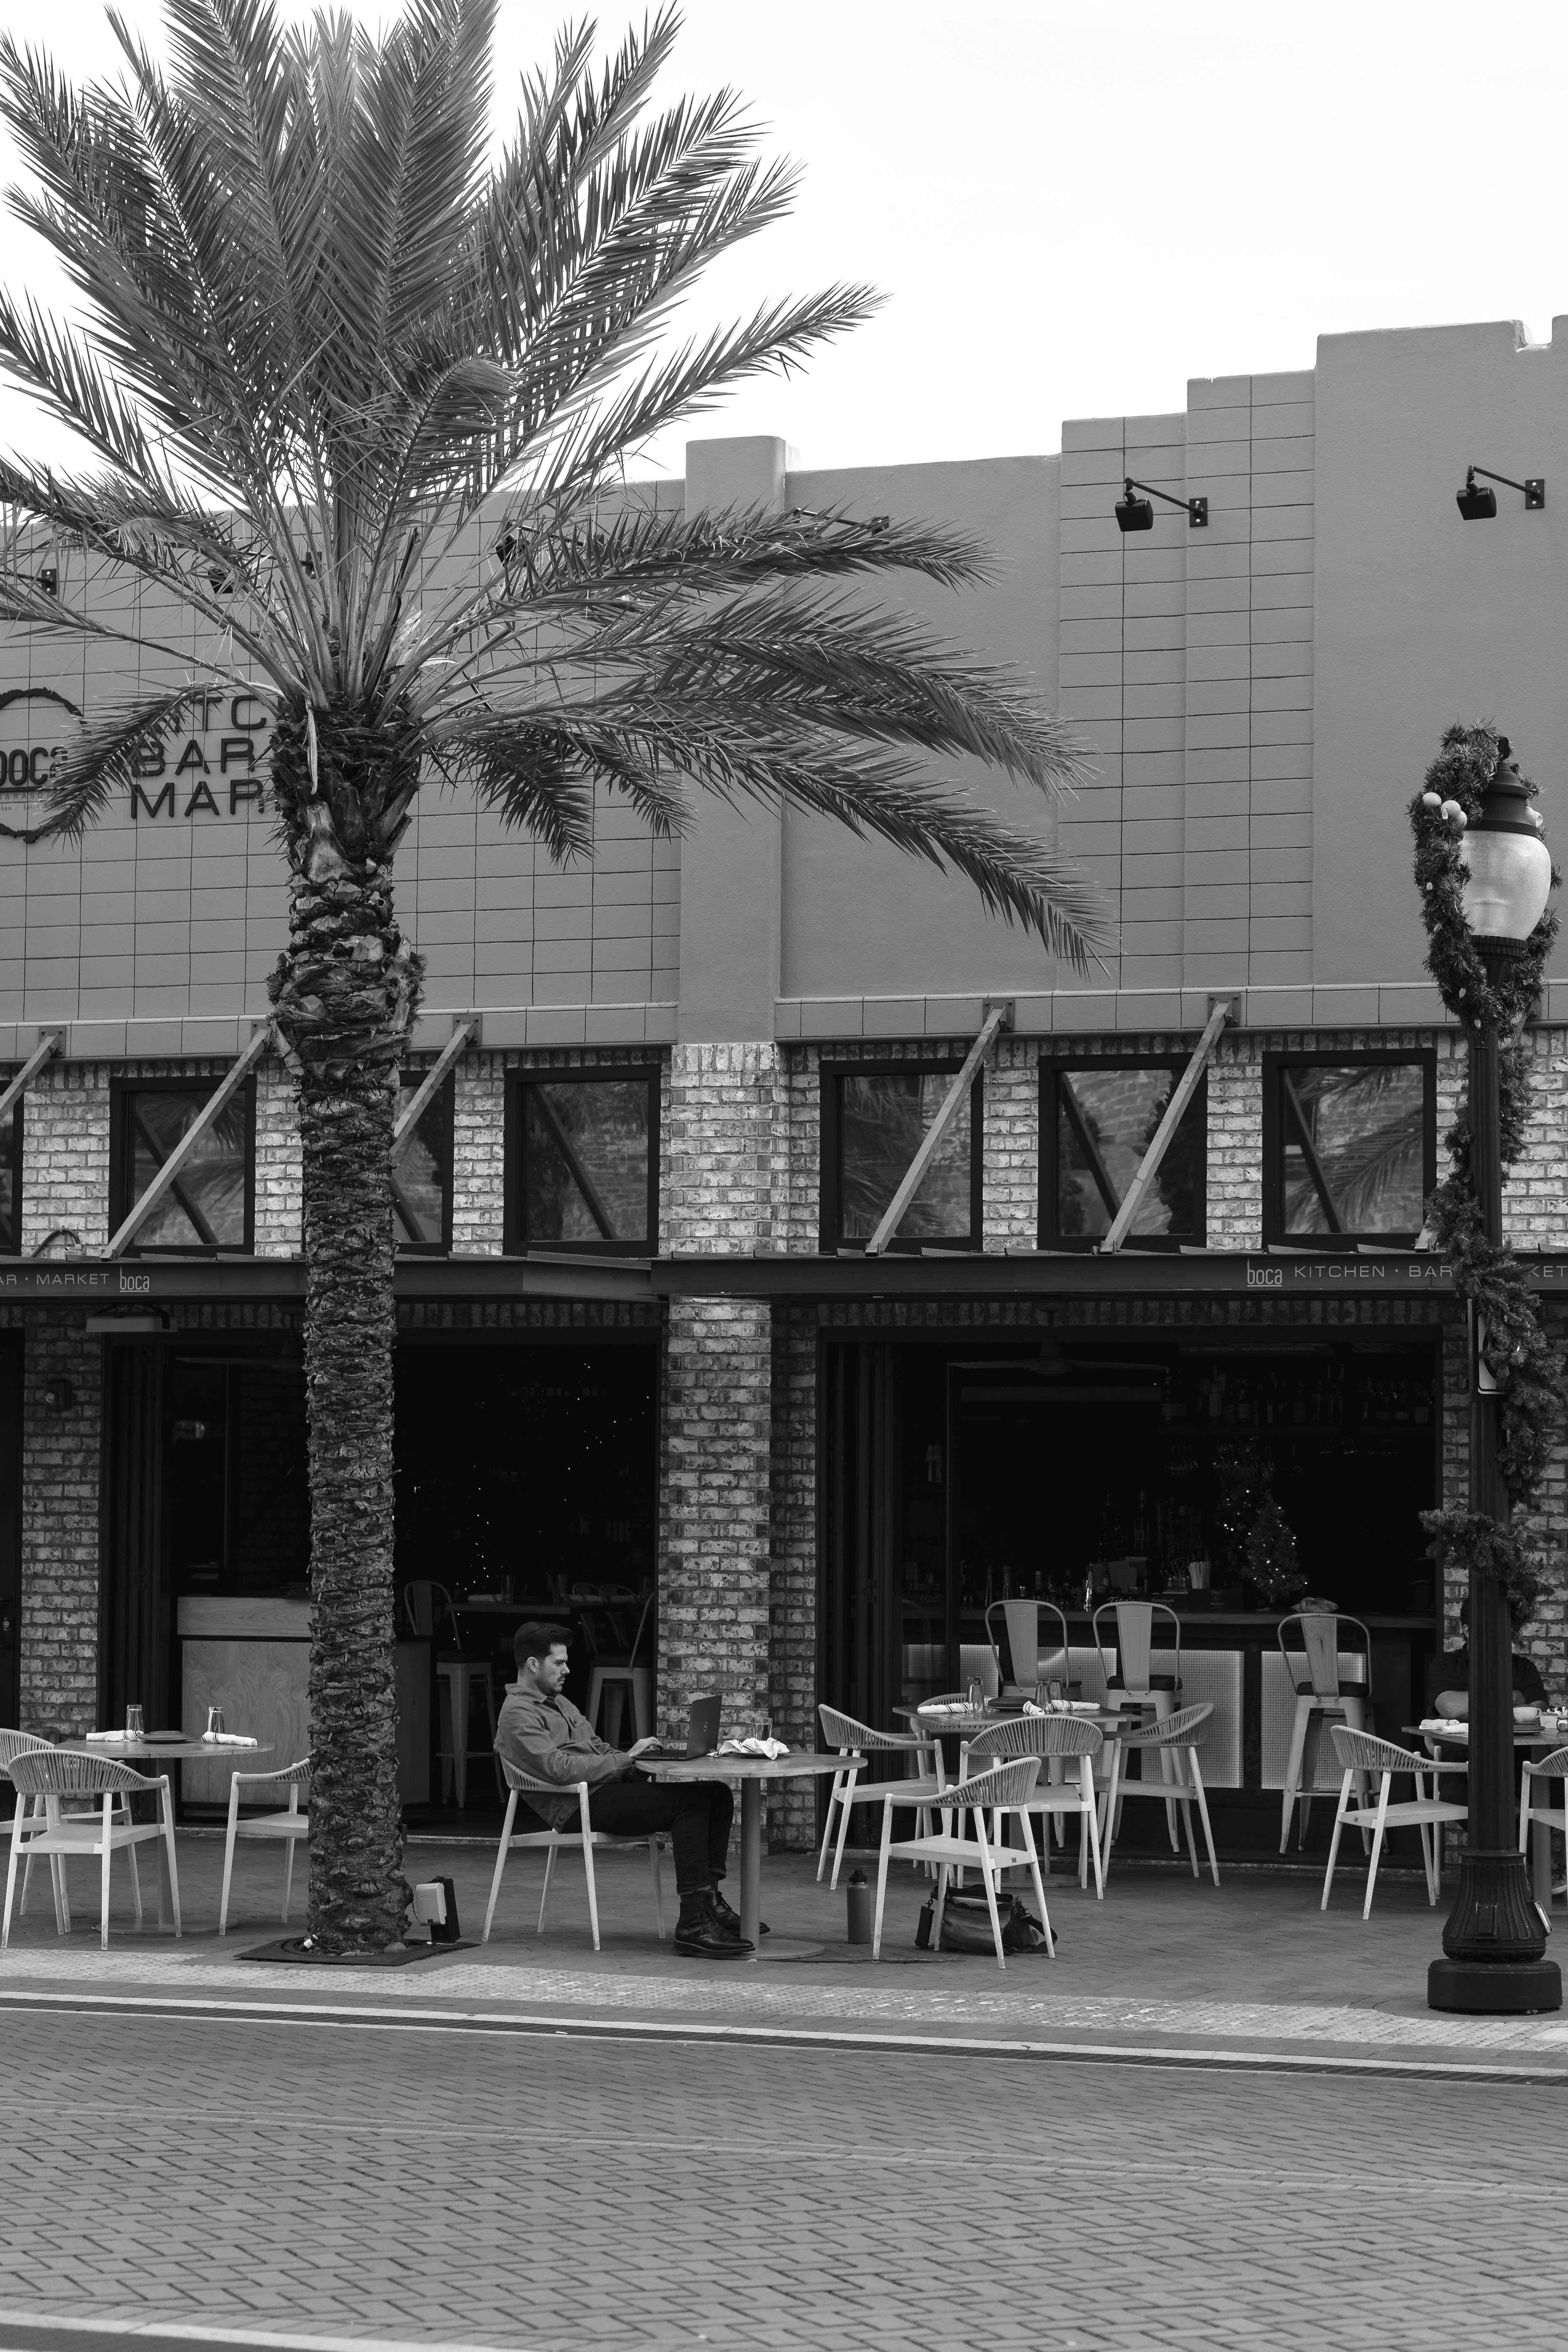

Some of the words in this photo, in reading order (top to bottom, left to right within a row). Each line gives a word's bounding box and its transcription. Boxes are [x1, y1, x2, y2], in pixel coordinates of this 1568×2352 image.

[131, 737, 254, 776] BAR
[131, 779, 281, 818] MAR
[37, 1274, 109, 1284] MARKET
[120, 1265, 150, 1290] boca
[1247, 1257, 1282, 1284] boca
[1295, 1266, 1384, 1277] KITCHEN
[1409, 1265, 1452, 1277] BAR
[1531, 1266, 1568, 1277] KET
